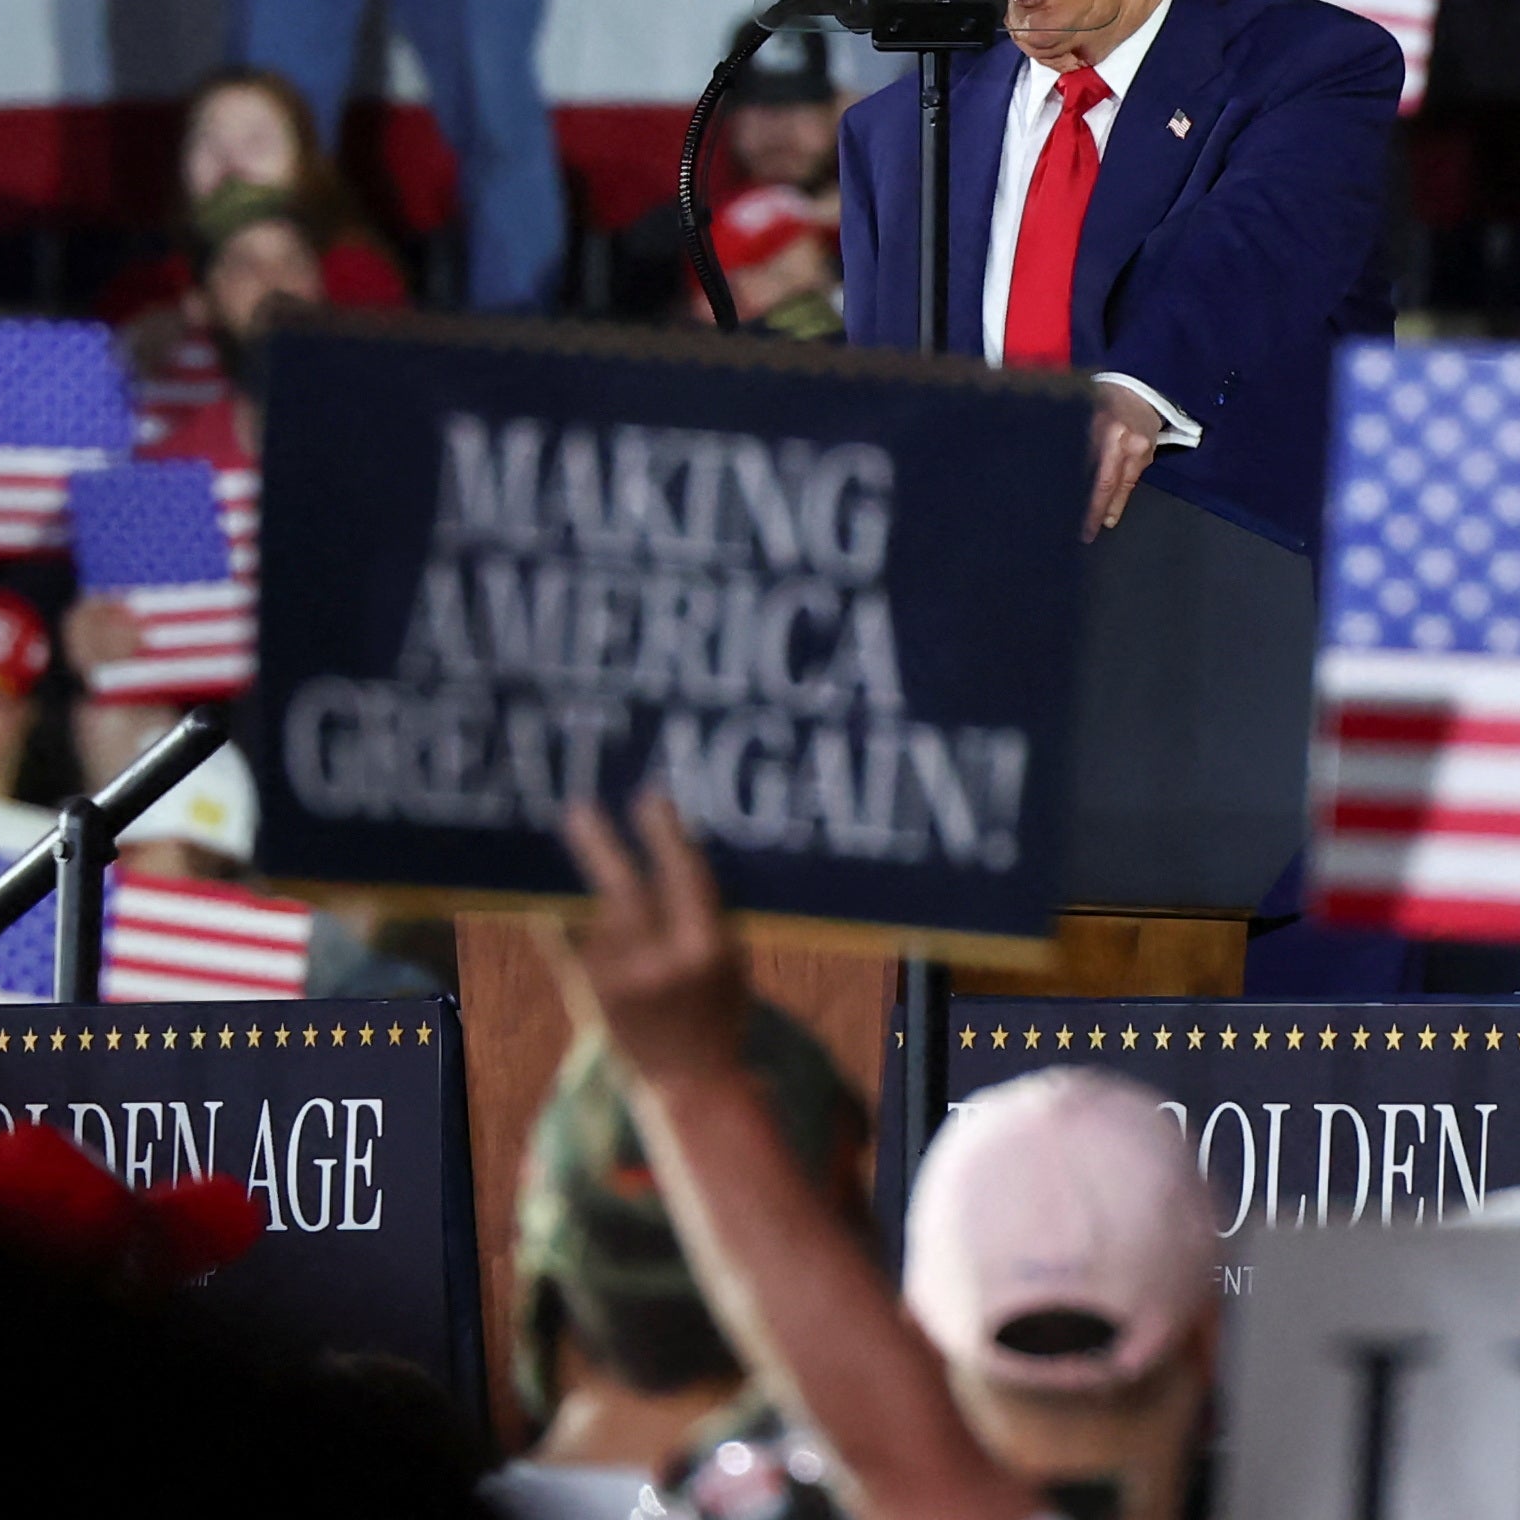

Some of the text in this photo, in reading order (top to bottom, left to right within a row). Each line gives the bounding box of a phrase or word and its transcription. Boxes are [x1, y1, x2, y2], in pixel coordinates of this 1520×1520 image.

[435, 410, 894, 584] MAKING
[396, 555, 906, 718] AMERICA
[282, 676, 1030, 872] GREAT AGAIN!
[246, 1097, 384, 1233] AGE
[1156, 1100, 1498, 1238] OLDEN
